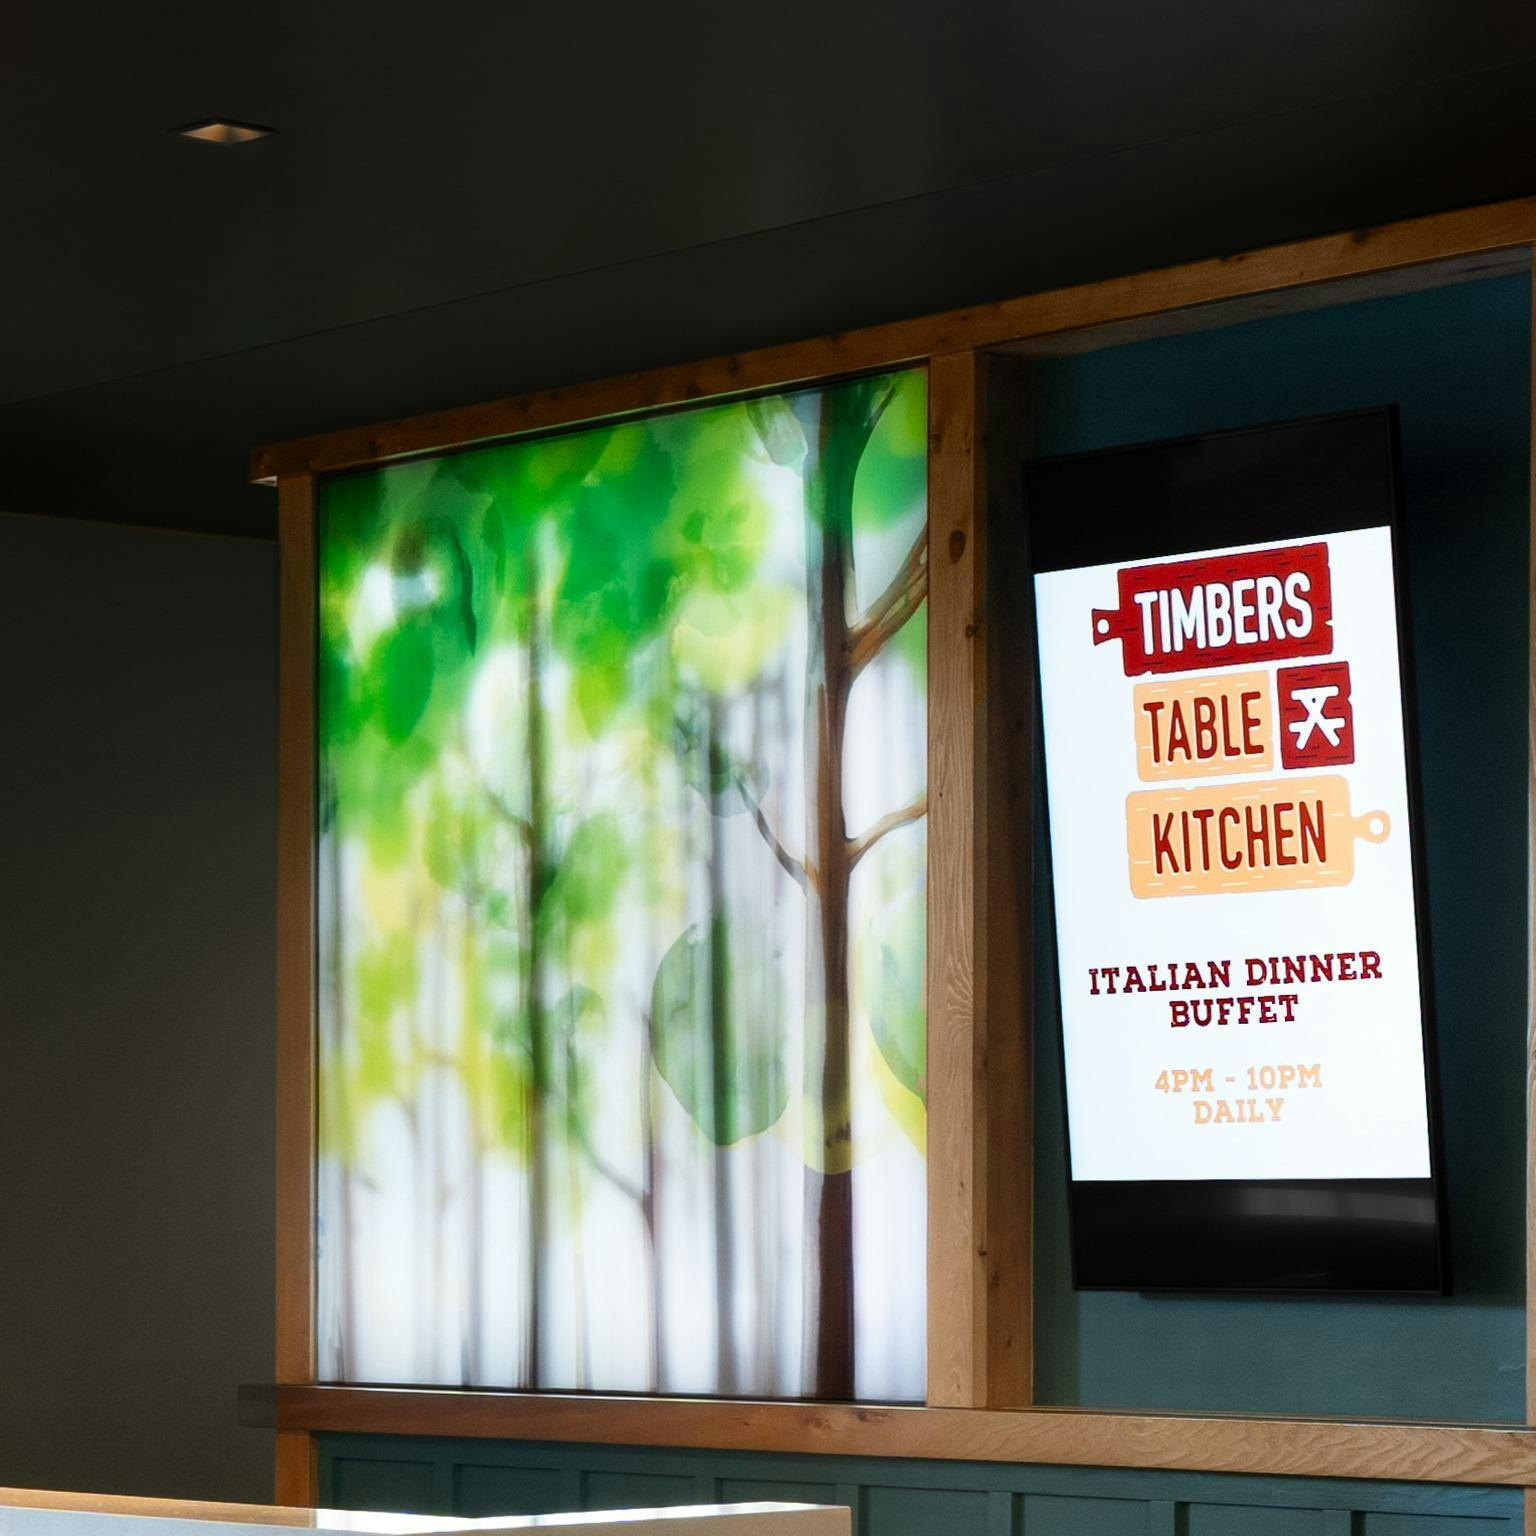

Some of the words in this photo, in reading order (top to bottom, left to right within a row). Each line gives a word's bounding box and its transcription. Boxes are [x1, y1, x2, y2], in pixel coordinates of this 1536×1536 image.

[1133, 571, 1313, 656] TIMBERS
[1143, 691, 1265, 764] TABLE
[1152, 799, 1327, 875] KITCHEN
[1088, 960, 1231, 995] ITALIAN
[1245, 951, 1382, 986] DINNER
[1169, 994, 1298, 1027] BUFFET
[1154, 1067, 1215, 1094] 4PM
[1246, 1063, 1323, 1091] 10PM
[1192, 1097, 1285, 1126] DAILY
